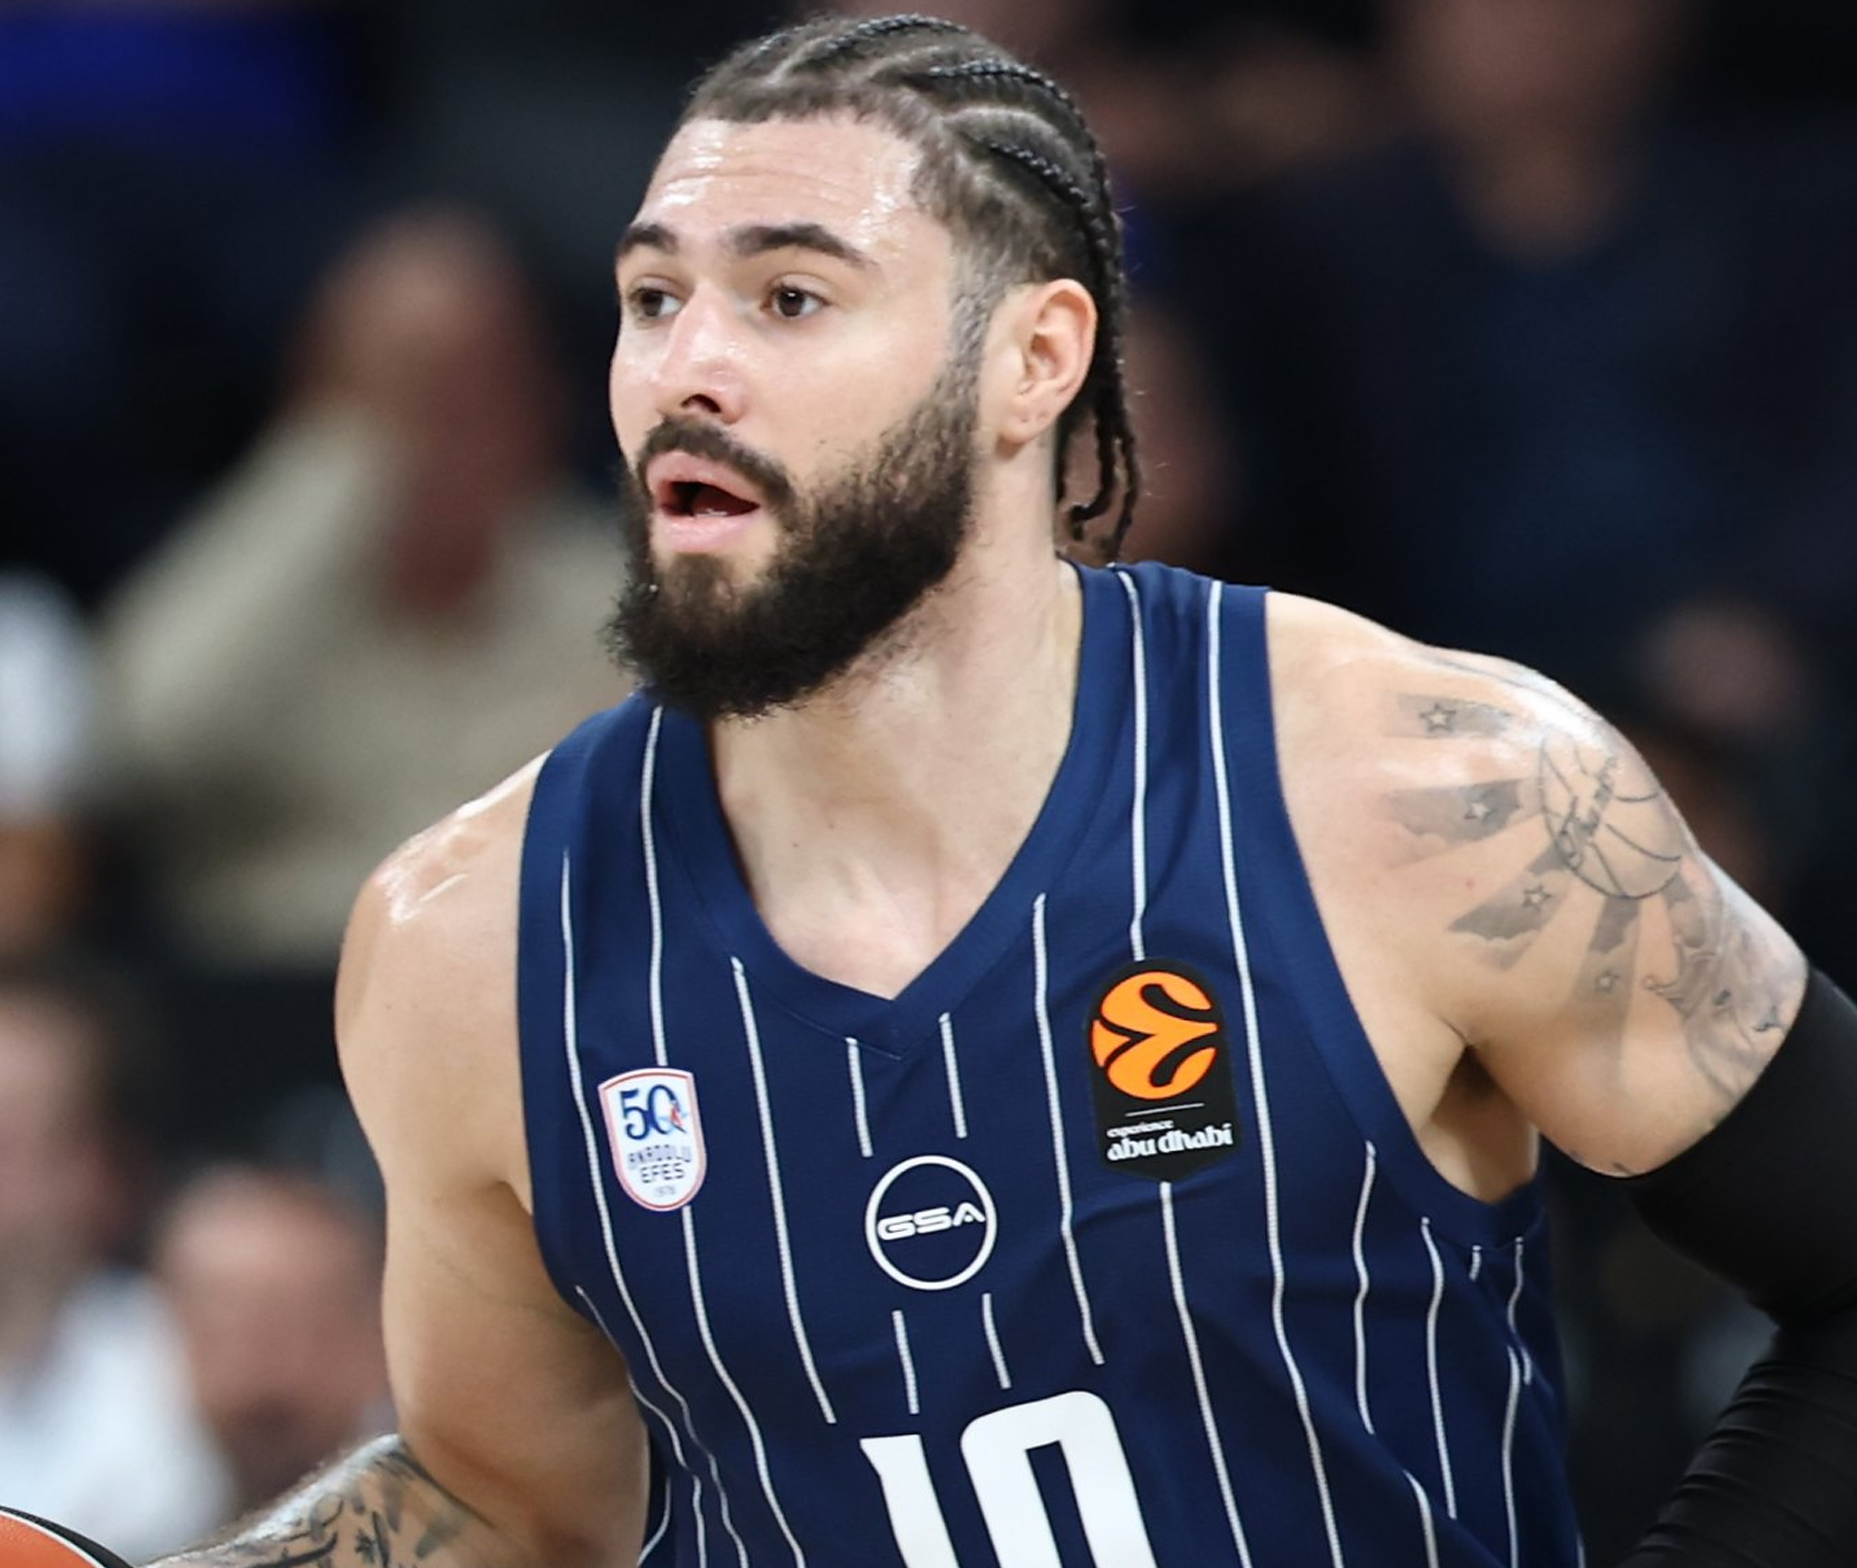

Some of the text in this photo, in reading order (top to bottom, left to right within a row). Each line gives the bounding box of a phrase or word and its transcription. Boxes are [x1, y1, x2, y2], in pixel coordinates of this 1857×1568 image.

[620, 1084, 686, 1140] 50
[1107, 1123, 1233, 1161] abu dhabi
[641, 1162, 685, 1184] EFES
[877, 1202, 986, 1240] GSA
